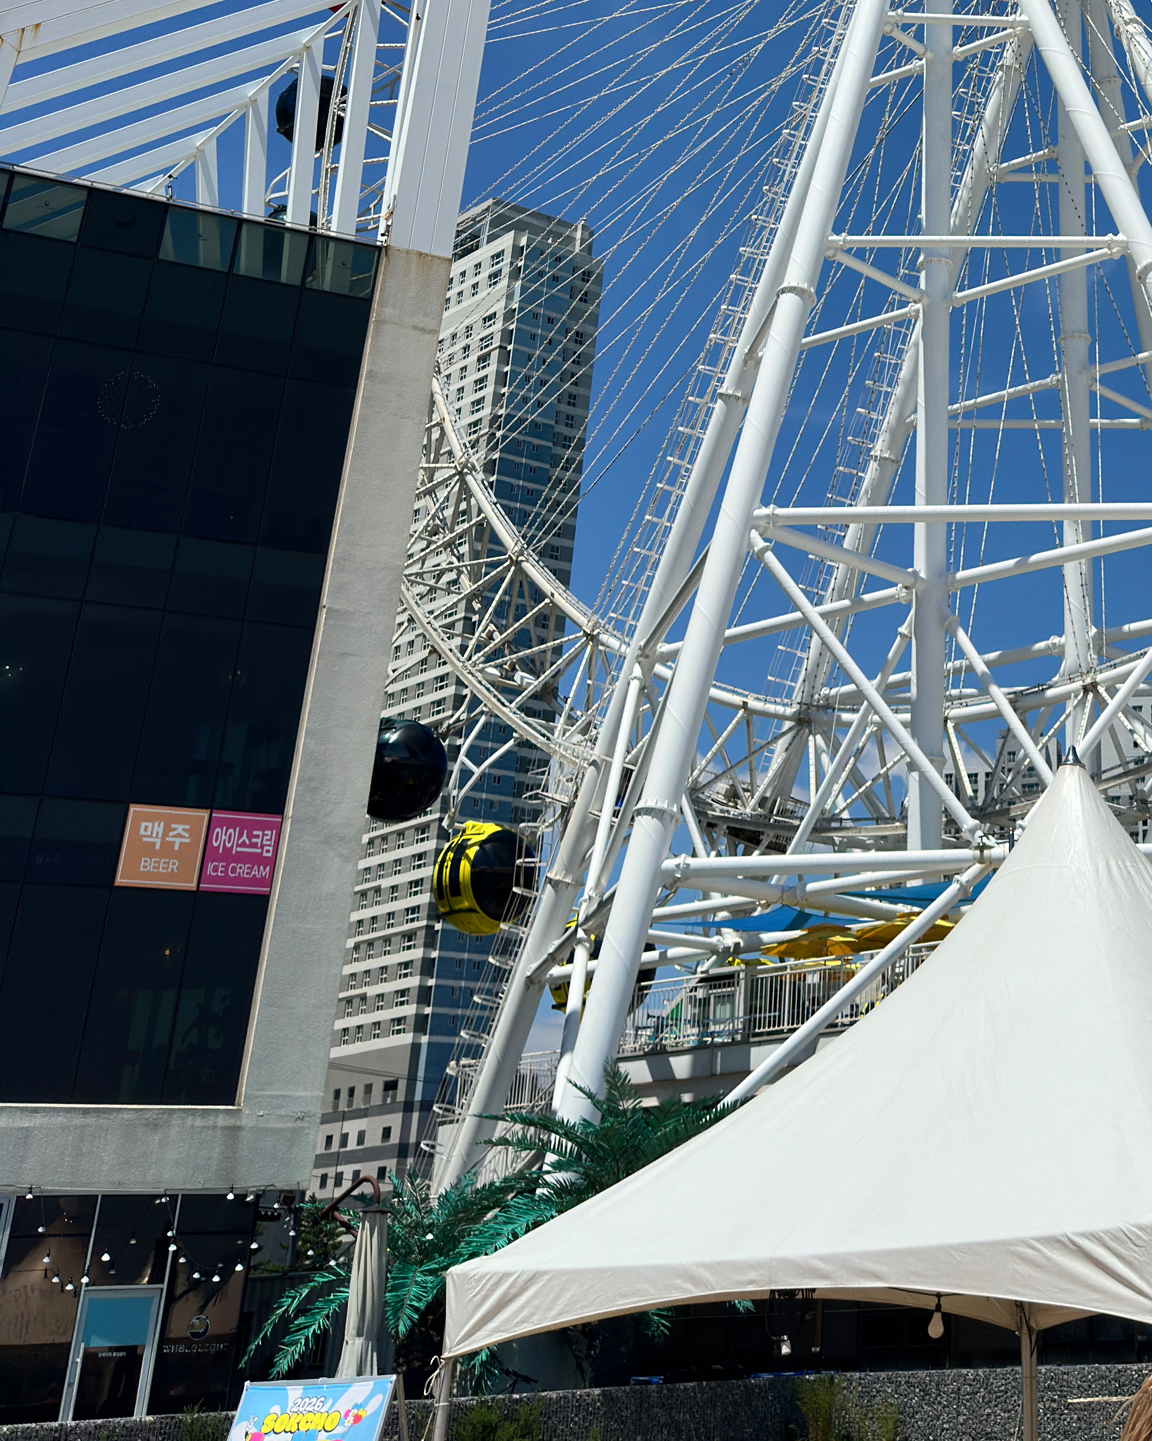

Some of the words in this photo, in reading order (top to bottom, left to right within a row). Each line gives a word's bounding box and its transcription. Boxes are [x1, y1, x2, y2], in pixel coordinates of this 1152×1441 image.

[139, 821, 191, 851] 맥주
[212, 826, 276, 857] 아이스크림
[140, 857, 179, 873] BEER
[207, 861, 227, 877] ICE
[228, 863, 270, 879] CREAM
[292, 1396, 326, 1413] 2026
[260, 1410, 341, 1435] SOKCHO
